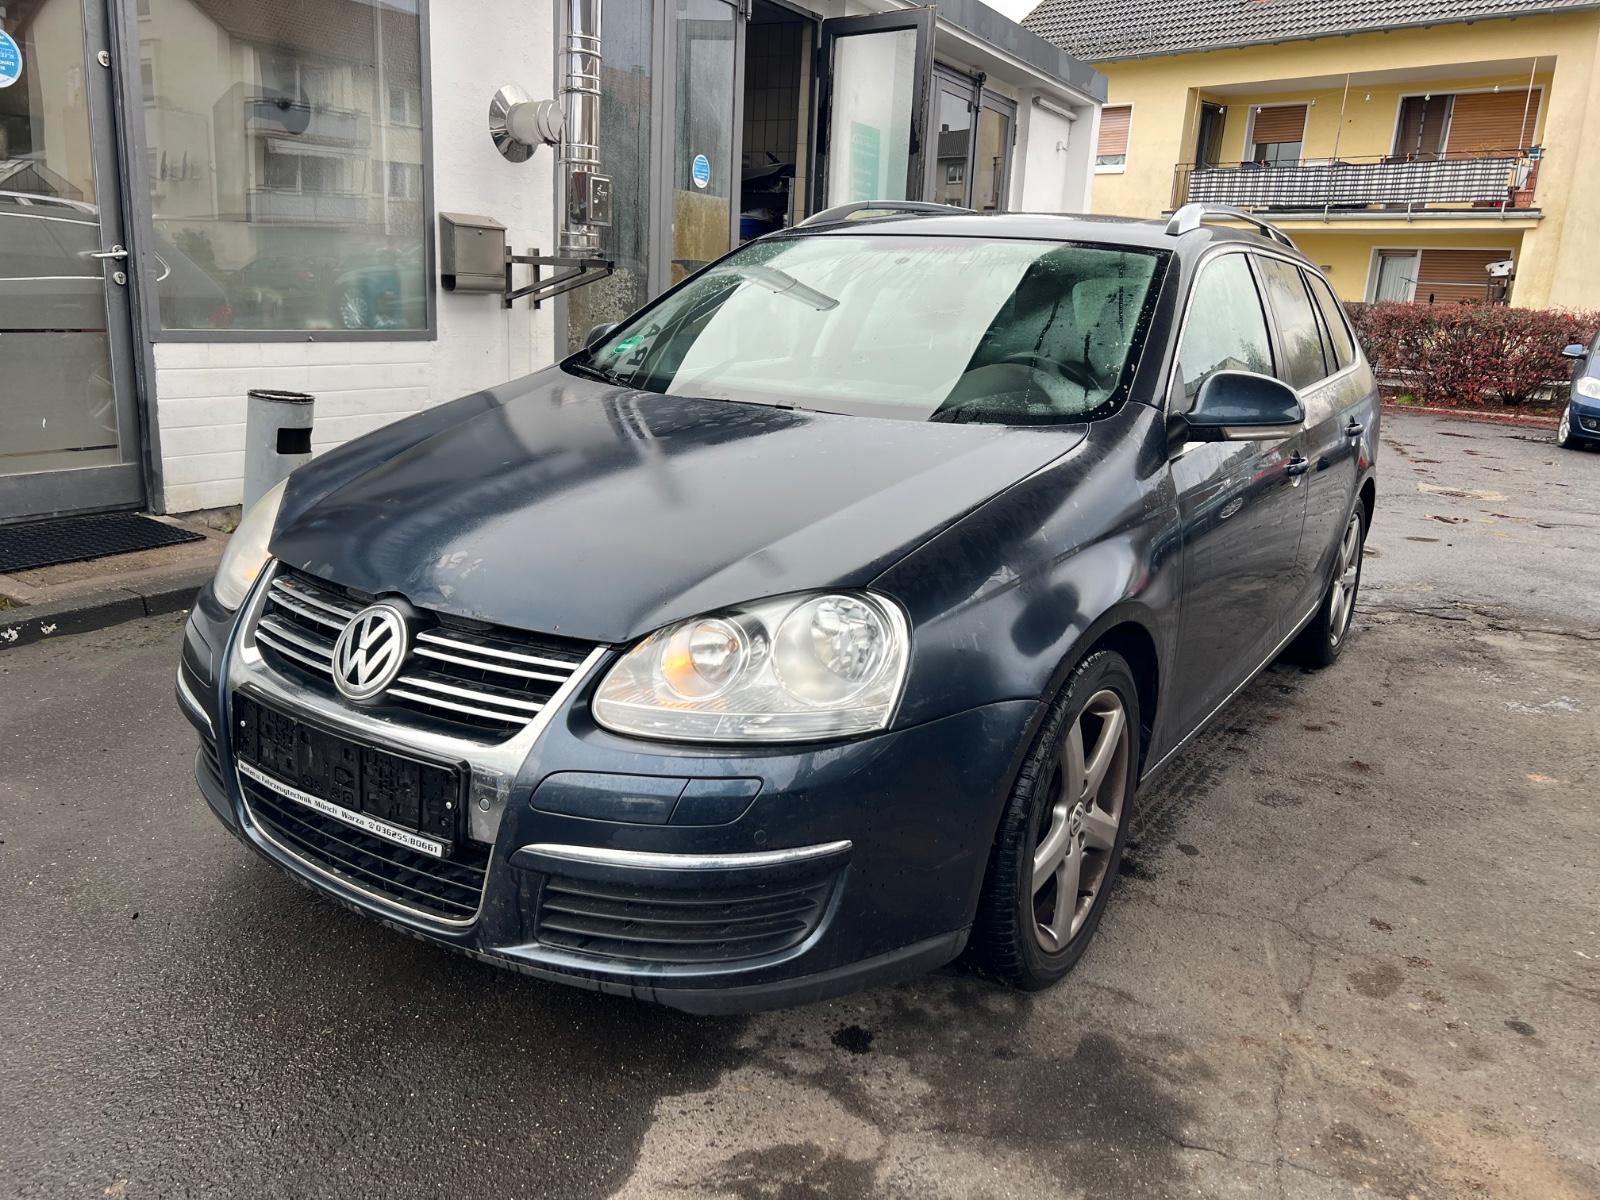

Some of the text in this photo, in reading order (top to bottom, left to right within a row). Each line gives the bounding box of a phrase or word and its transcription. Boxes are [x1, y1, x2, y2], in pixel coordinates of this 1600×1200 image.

[337, 609, 401, 692] VW
[262, 775, 312, 804] Fahrzeugtechnik
[314, 800, 338, 815] Münch
[341, 810, 365, 826] Warza
